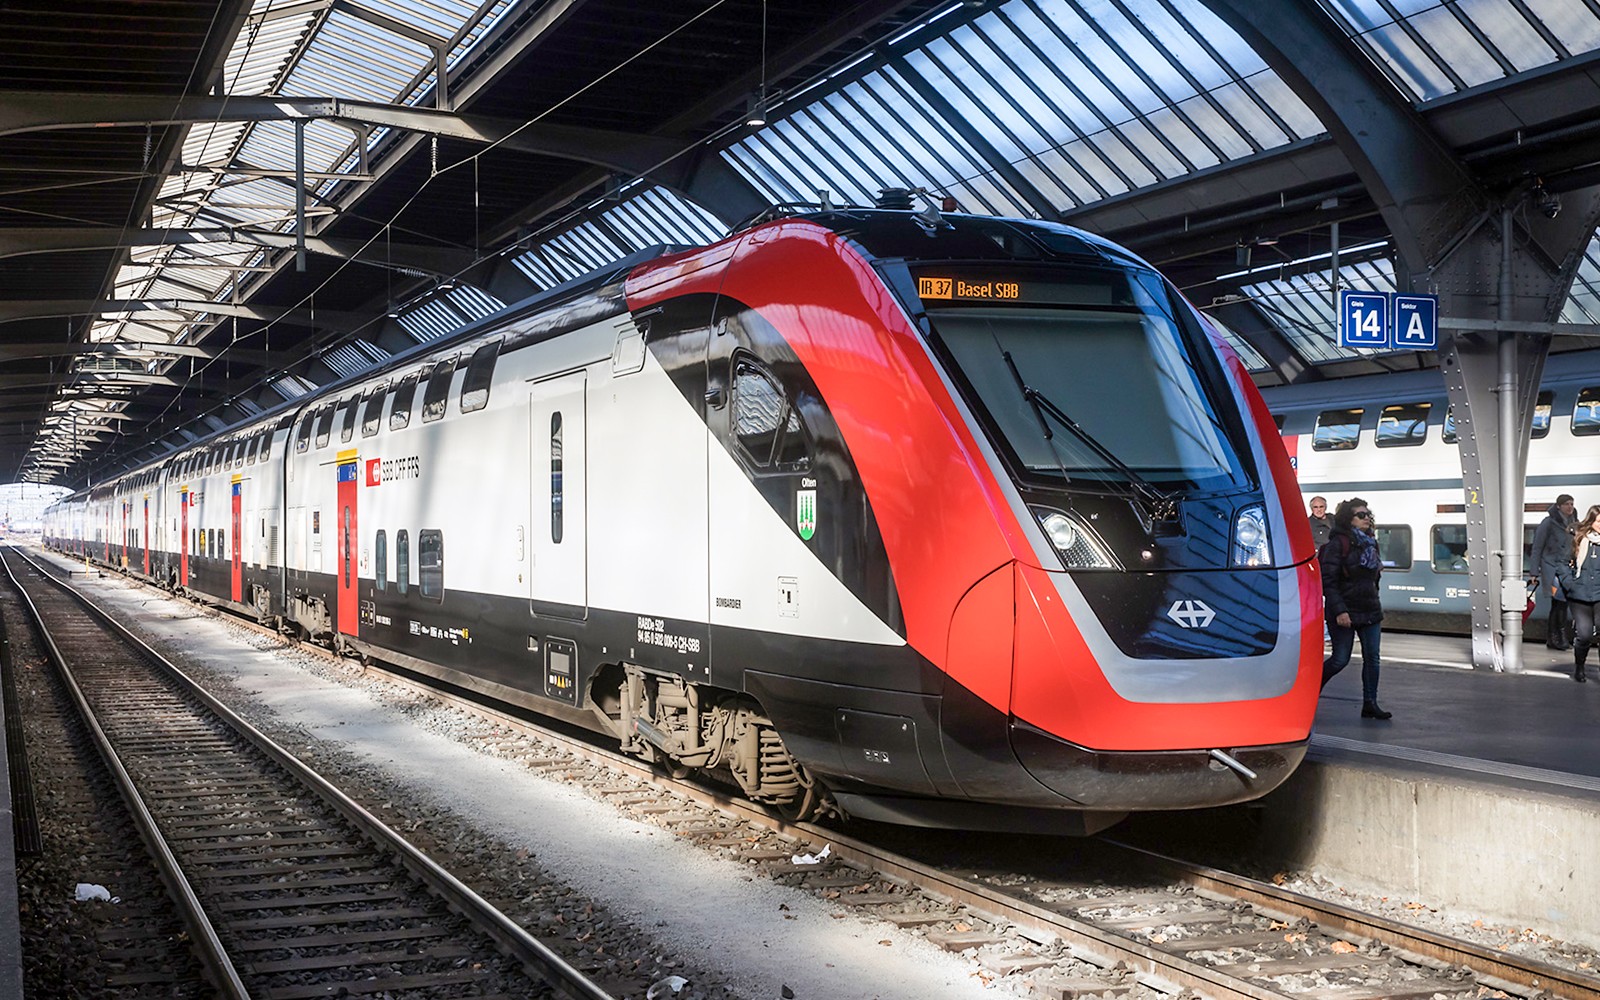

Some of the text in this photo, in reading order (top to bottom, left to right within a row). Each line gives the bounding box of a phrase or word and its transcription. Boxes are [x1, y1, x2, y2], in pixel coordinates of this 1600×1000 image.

[921, 280, 1019, 299] IR 37 Basel SBB
[1352, 309, 1380, 338] 14
[1405, 312, 1425, 339] A
[382, 456, 420, 482] SBB CFF FFS
[1290, 457, 1297, 469] 2
[801, 477, 816, 487] Olten
[1470, 491, 1478, 504] 2
[716, 597, 741, 609] BOMBARDIER
[638, 616, 665, 633] RABDe 502
[638, 630, 644, 642] 94
[678, 635, 700, 653] CH-SBB
